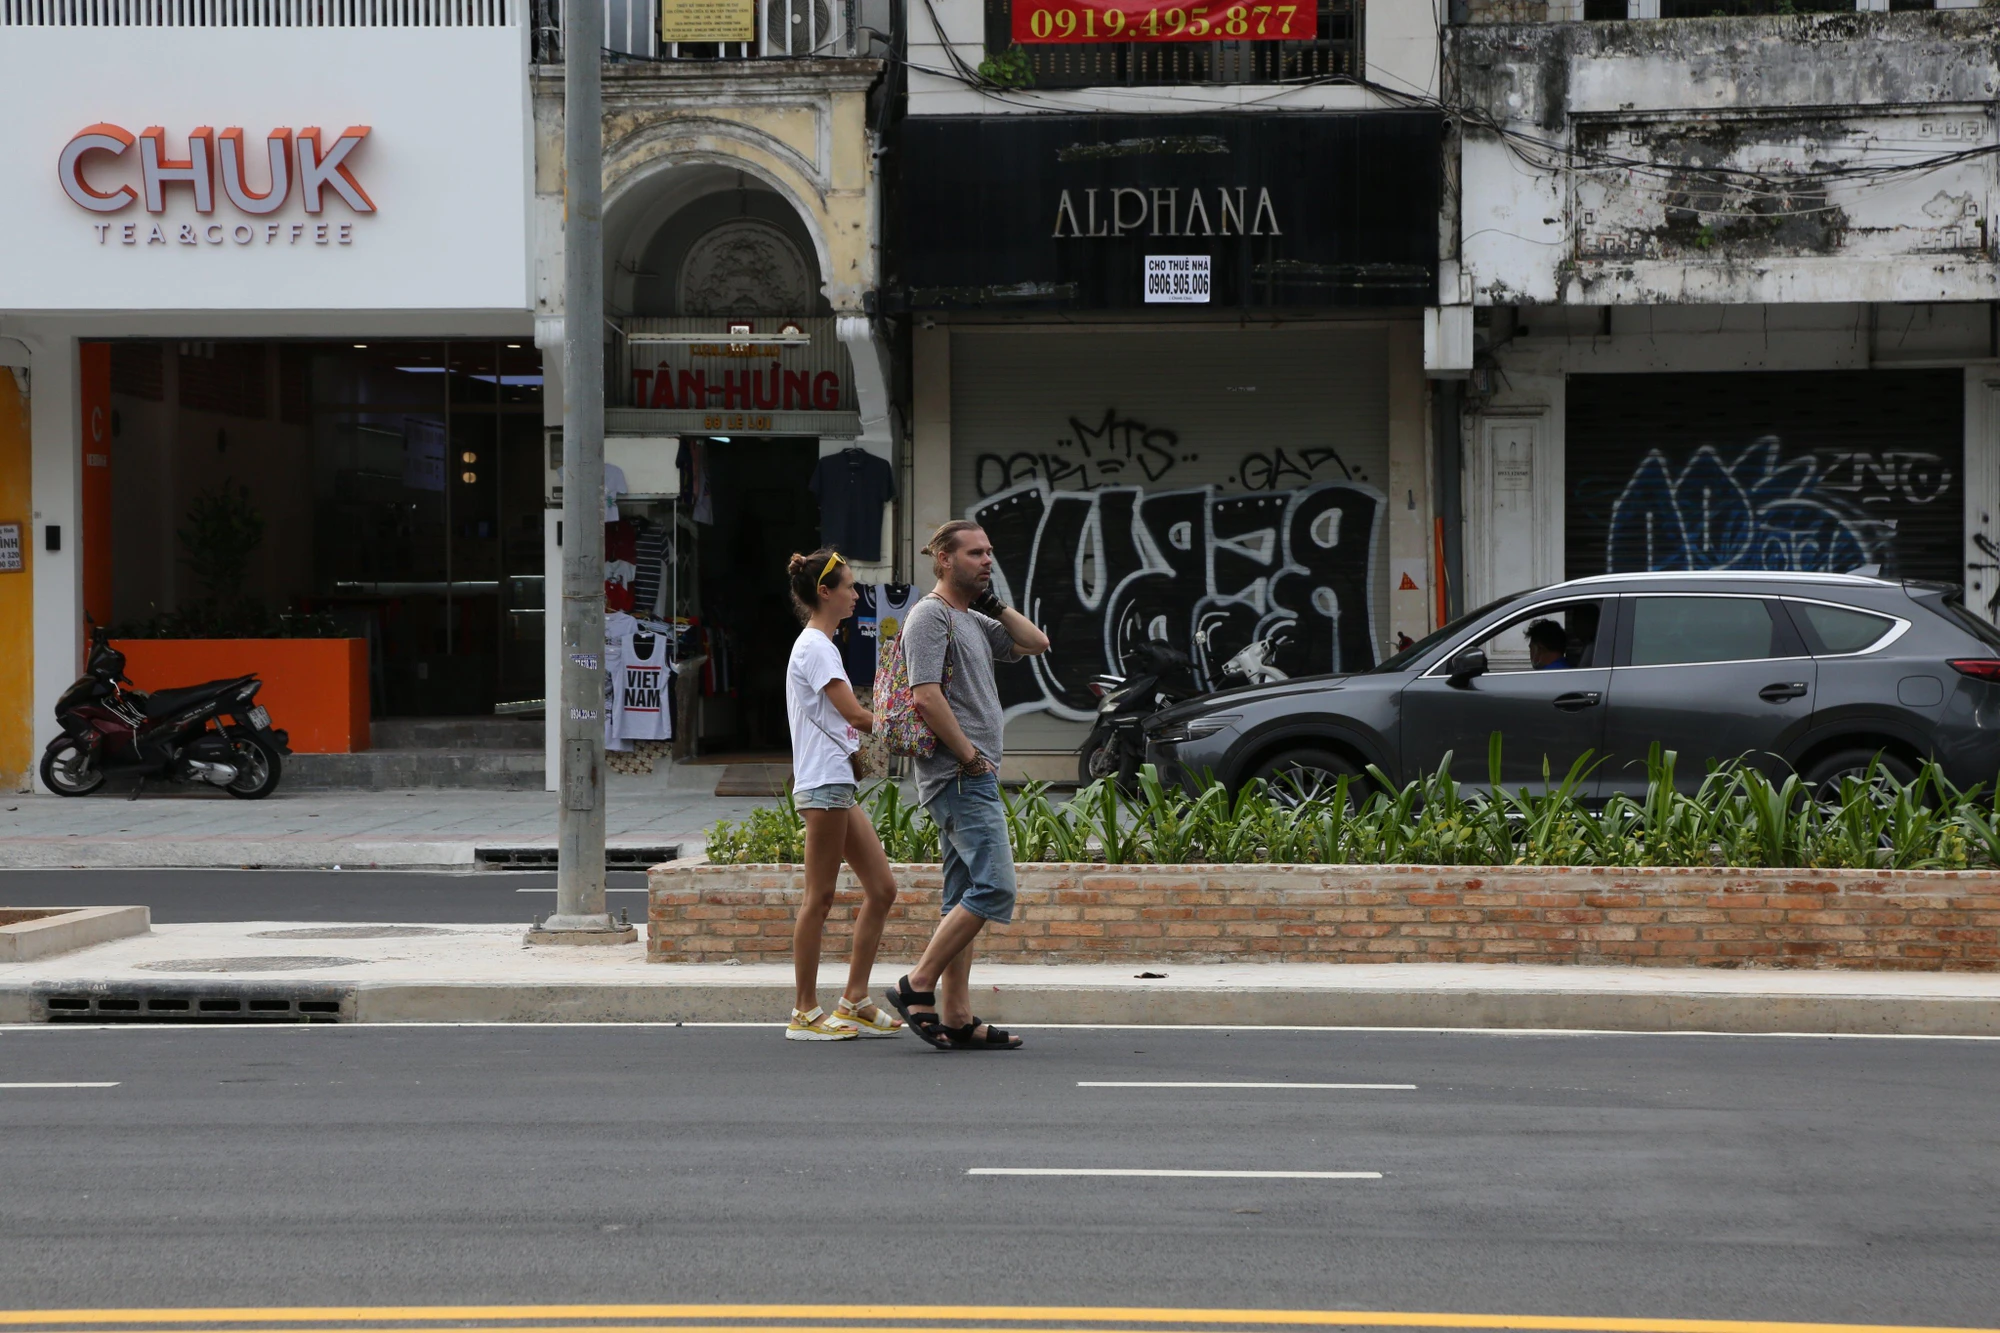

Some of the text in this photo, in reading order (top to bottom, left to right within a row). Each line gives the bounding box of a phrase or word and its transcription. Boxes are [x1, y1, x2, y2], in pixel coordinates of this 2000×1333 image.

[1030, 5, 1298, 38] 0919.495.877
[58, 122, 377, 213] CHUK
[1051, 186, 1283, 238] ALPHANA
[94, 222, 353, 245] TEA&COFFEE
[1148, 257, 1209, 271] CHO THUÊ NHÀ
[1148, 273, 1209, 295] 0906.905.006
[626, 670, 660, 689] VIET
[624, 688, 661, 708] NAM
